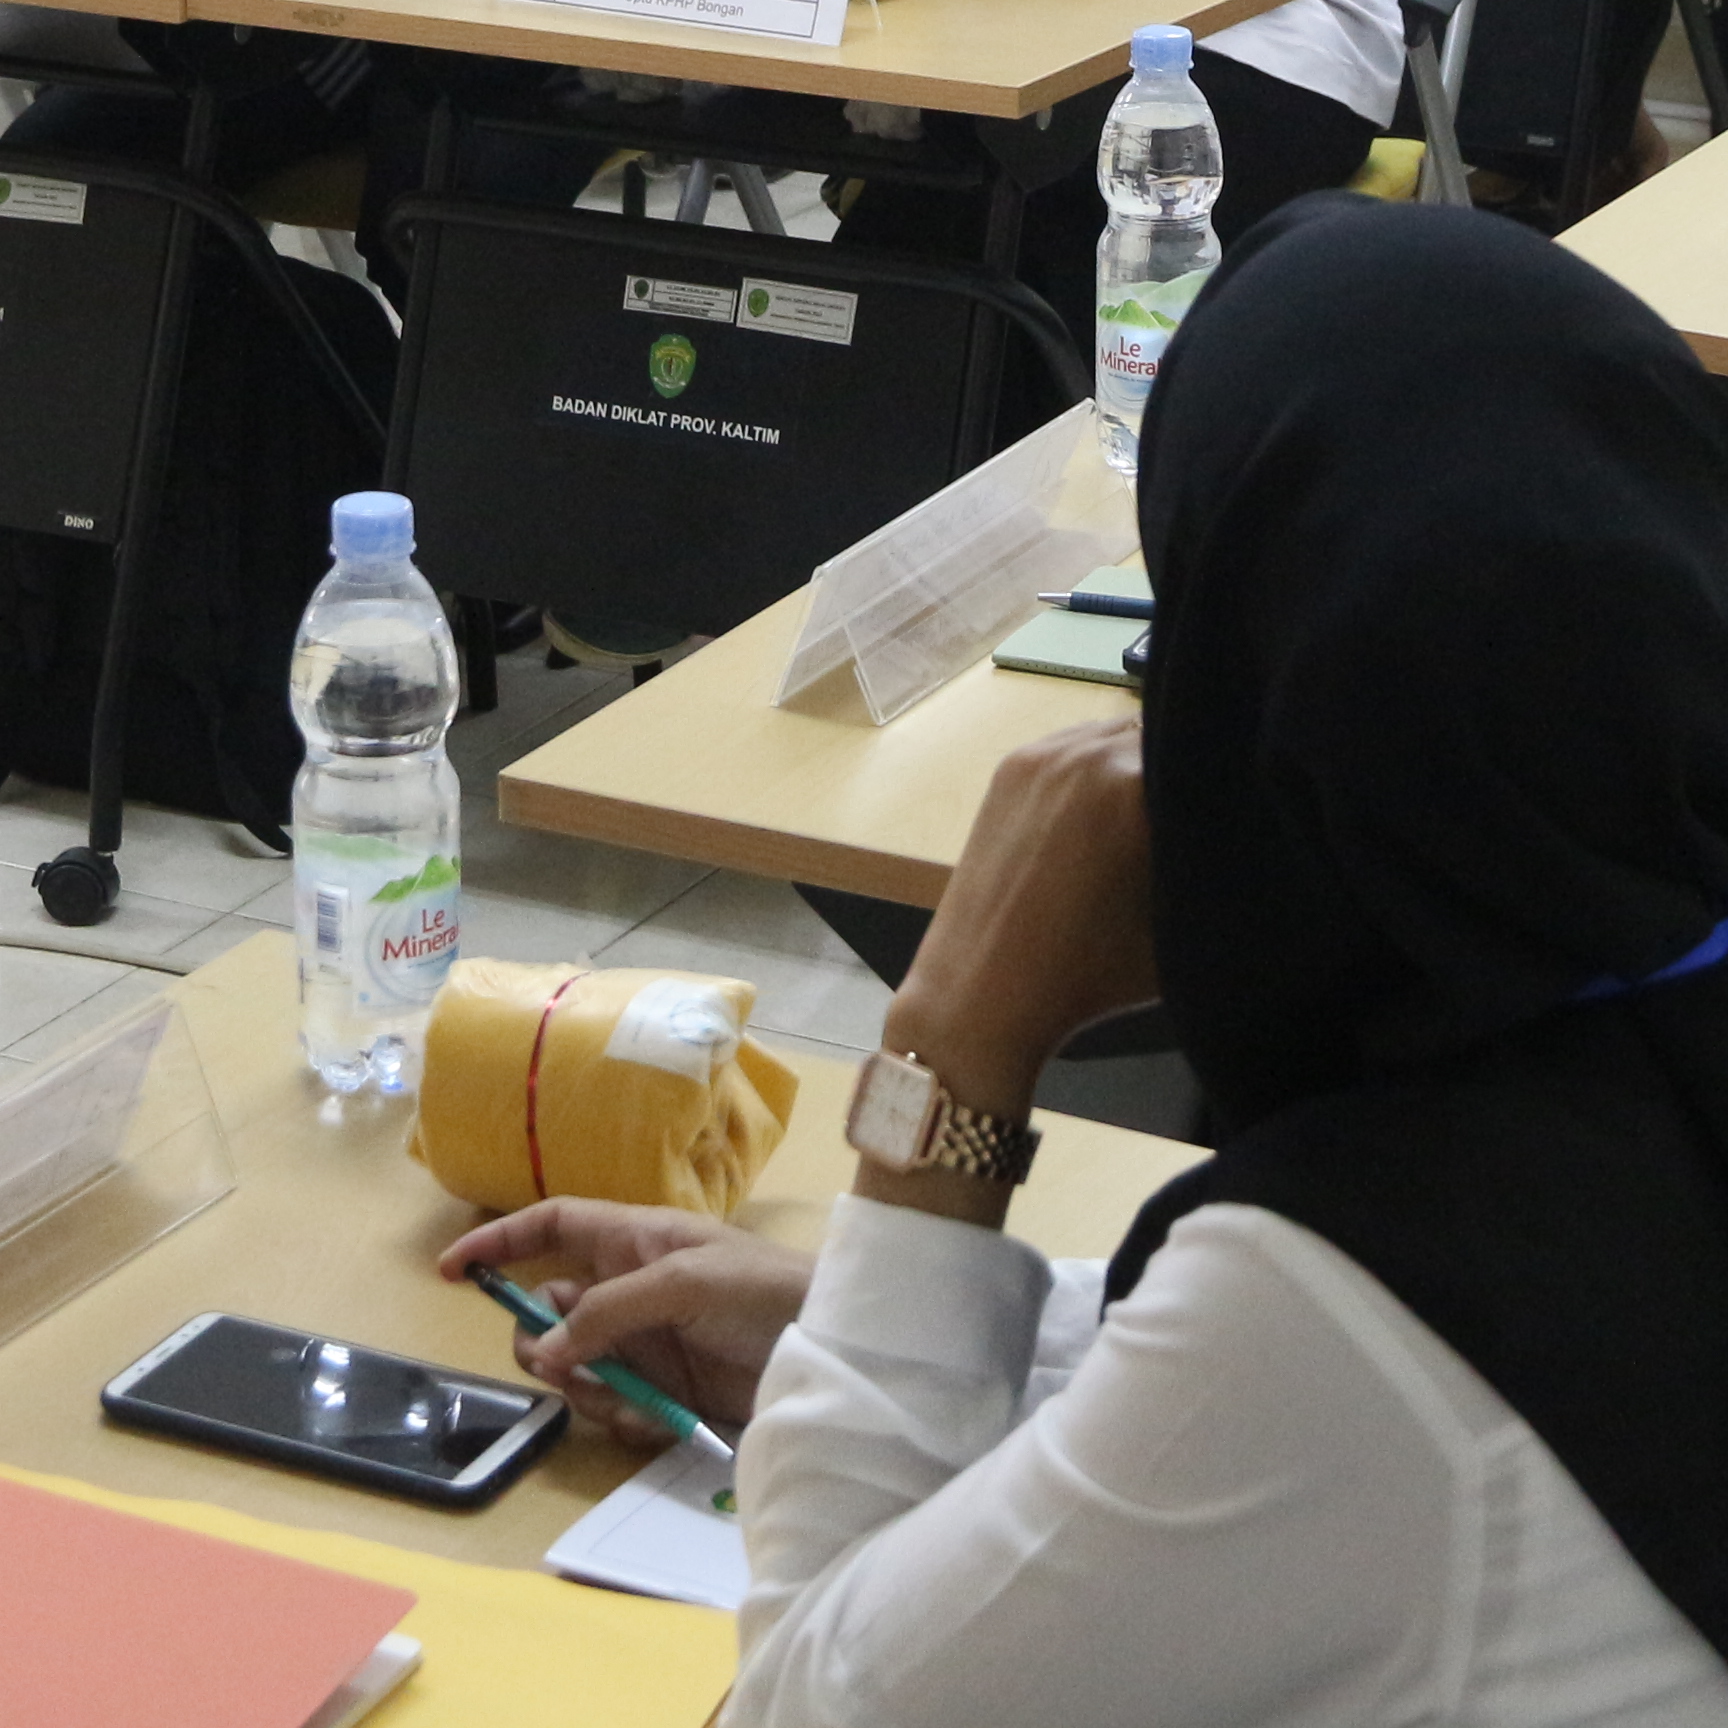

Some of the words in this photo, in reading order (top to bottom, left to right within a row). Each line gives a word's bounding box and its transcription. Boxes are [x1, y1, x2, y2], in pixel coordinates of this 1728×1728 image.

[1100, 346, 1162, 376] Mineral
[1119, 335, 1142, 359] Le
[551, 395, 608, 420] BADAN
[610, 402, 668, 429] DIKLAT
[670, 411, 718, 436] PROV.
[720, 421, 782, 446] KALTIM
[421, 908, 446, 934] Le
